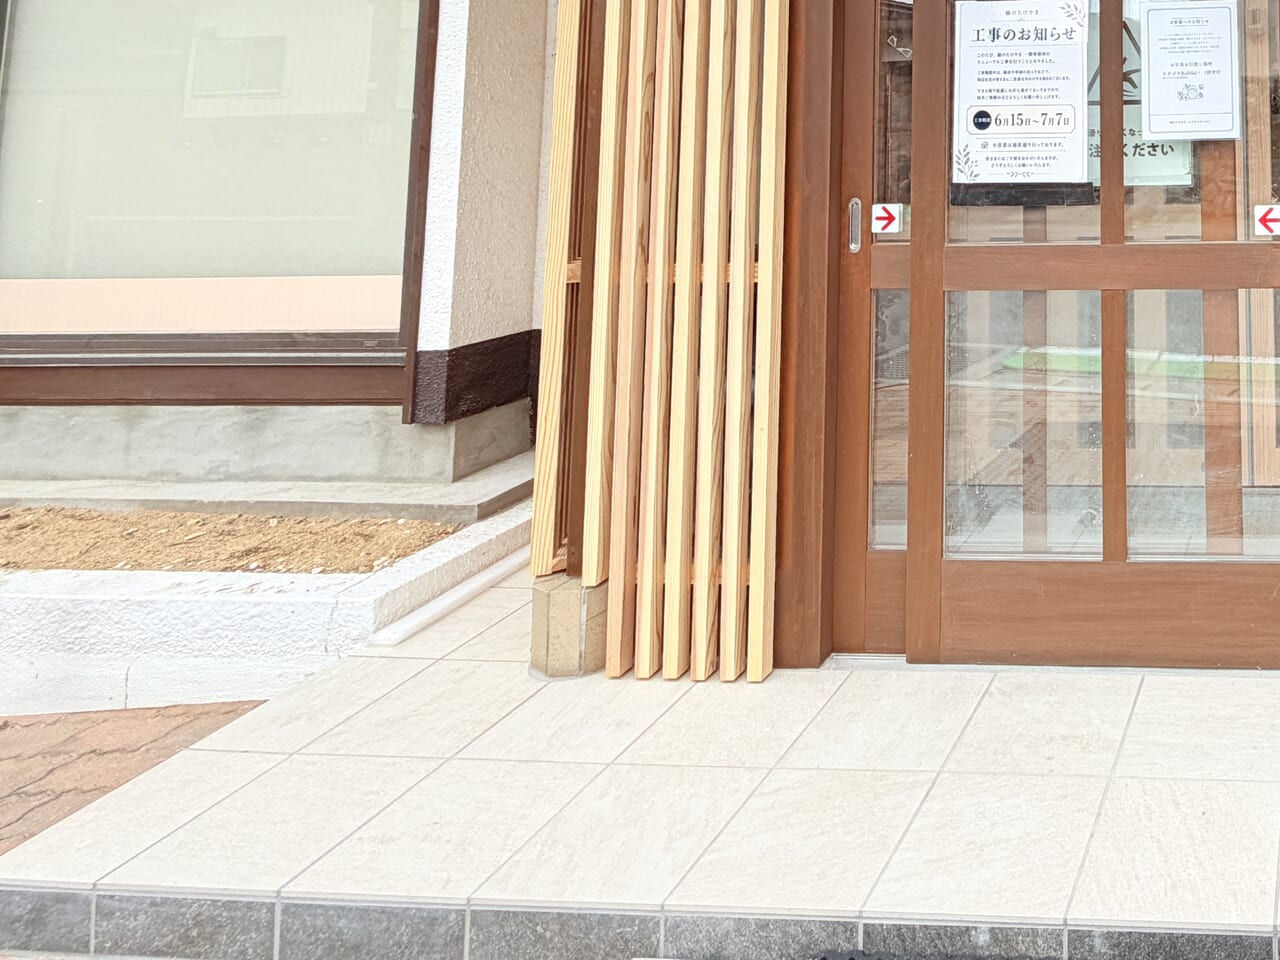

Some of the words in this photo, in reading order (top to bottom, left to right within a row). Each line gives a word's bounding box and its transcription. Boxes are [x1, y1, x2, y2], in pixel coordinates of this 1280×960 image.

[971, 26, 1077, 43] 工事のお知らせ
